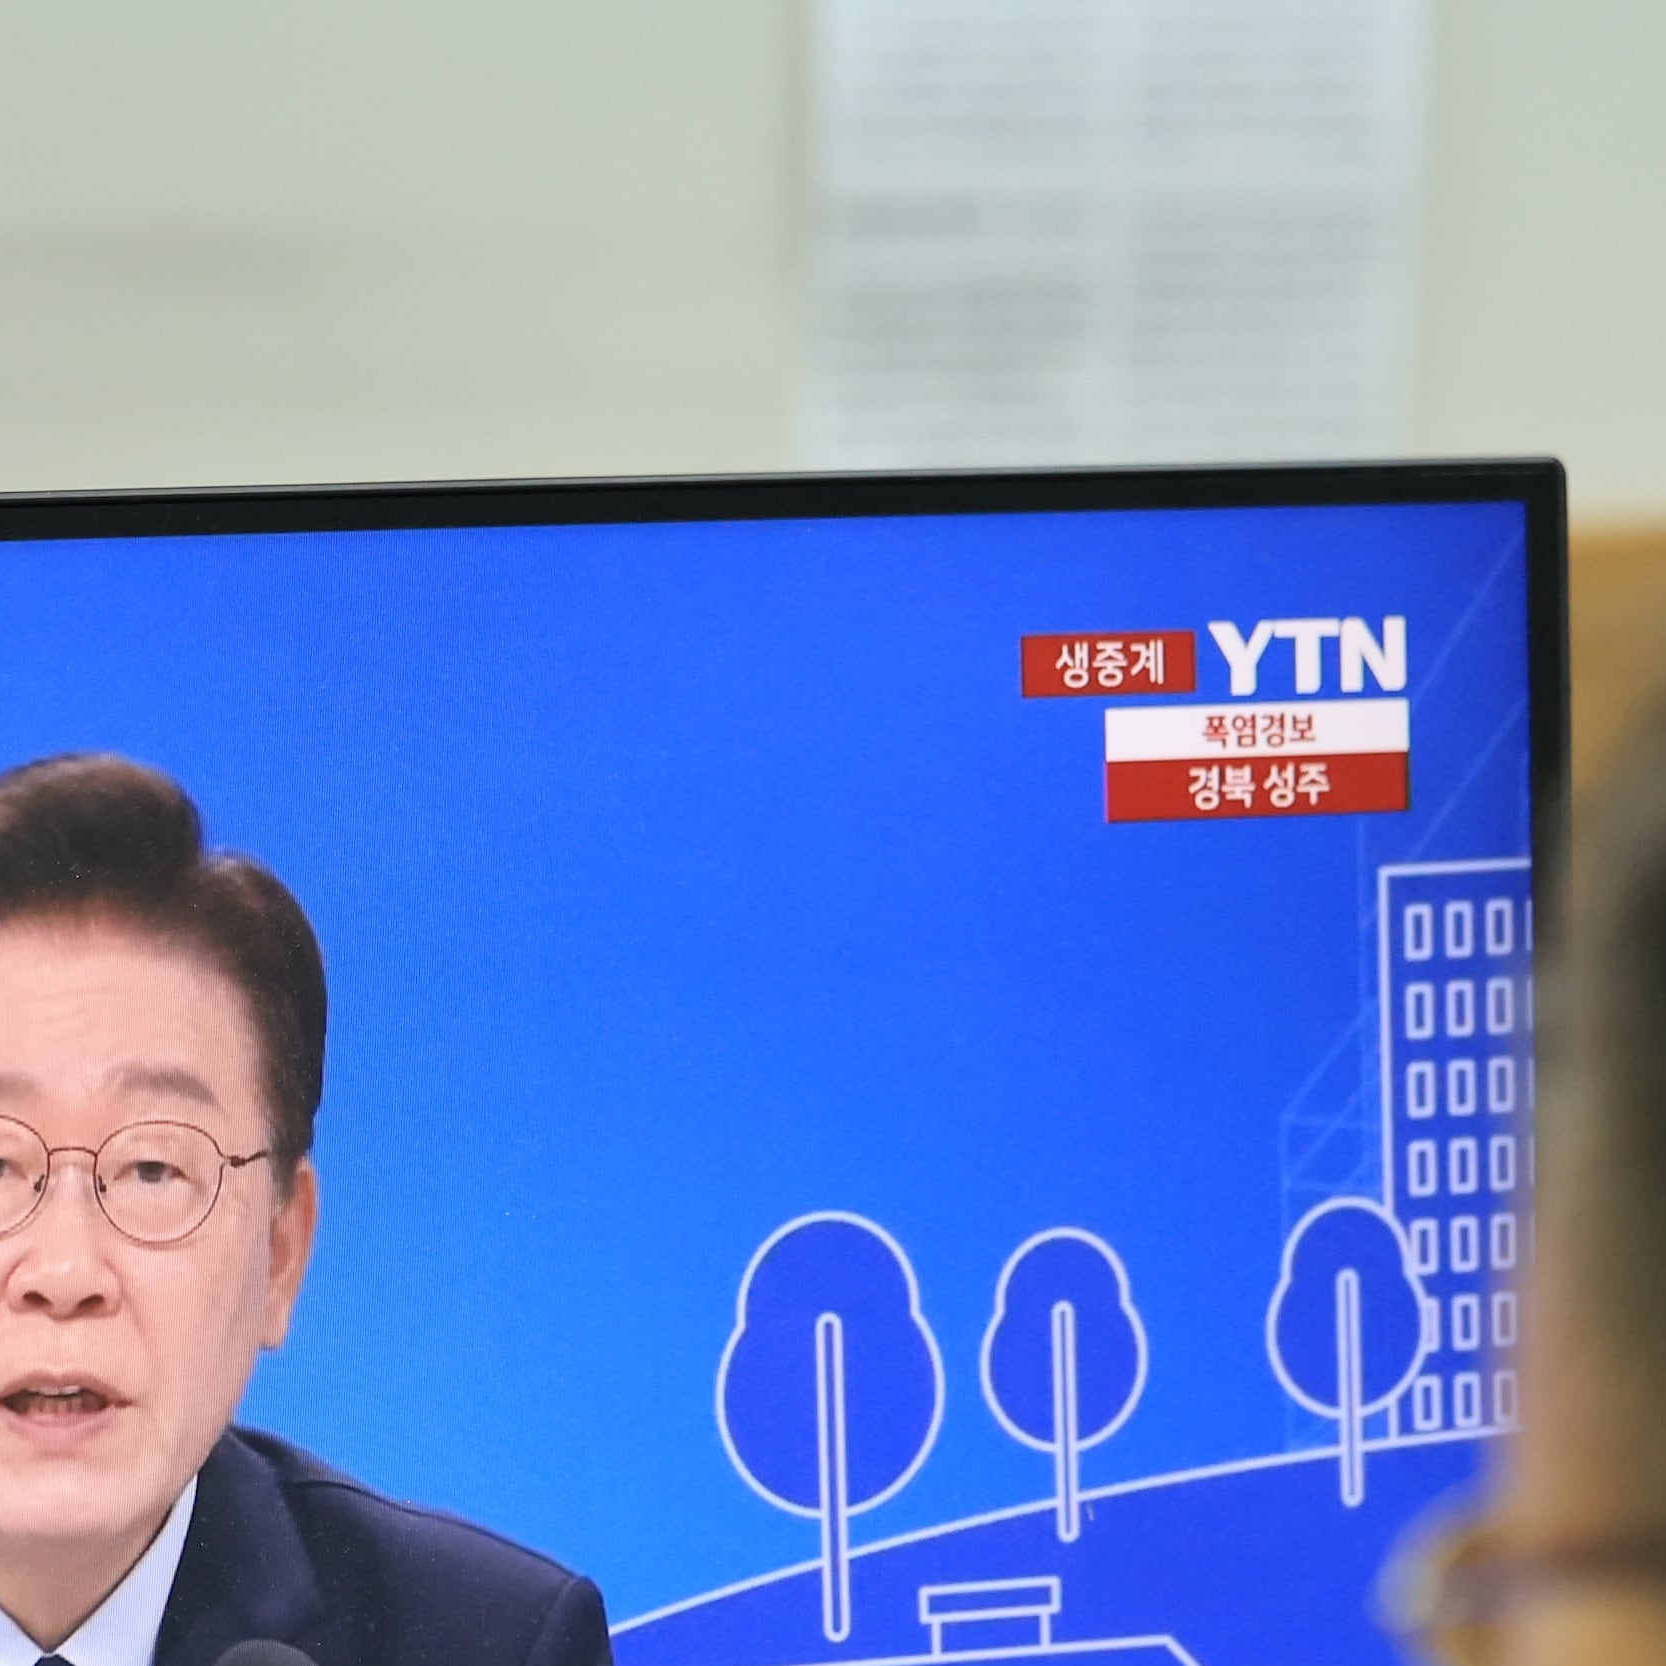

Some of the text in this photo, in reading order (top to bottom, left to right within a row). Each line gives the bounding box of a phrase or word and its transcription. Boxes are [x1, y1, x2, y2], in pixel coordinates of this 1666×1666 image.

[1054, 638, 1165, 688] 생중계
[1207, 616, 1407, 696] YTN
[1202, 713, 1317, 748] 폭염경보
[1188, 761, 1331, 811] 경북 성주
